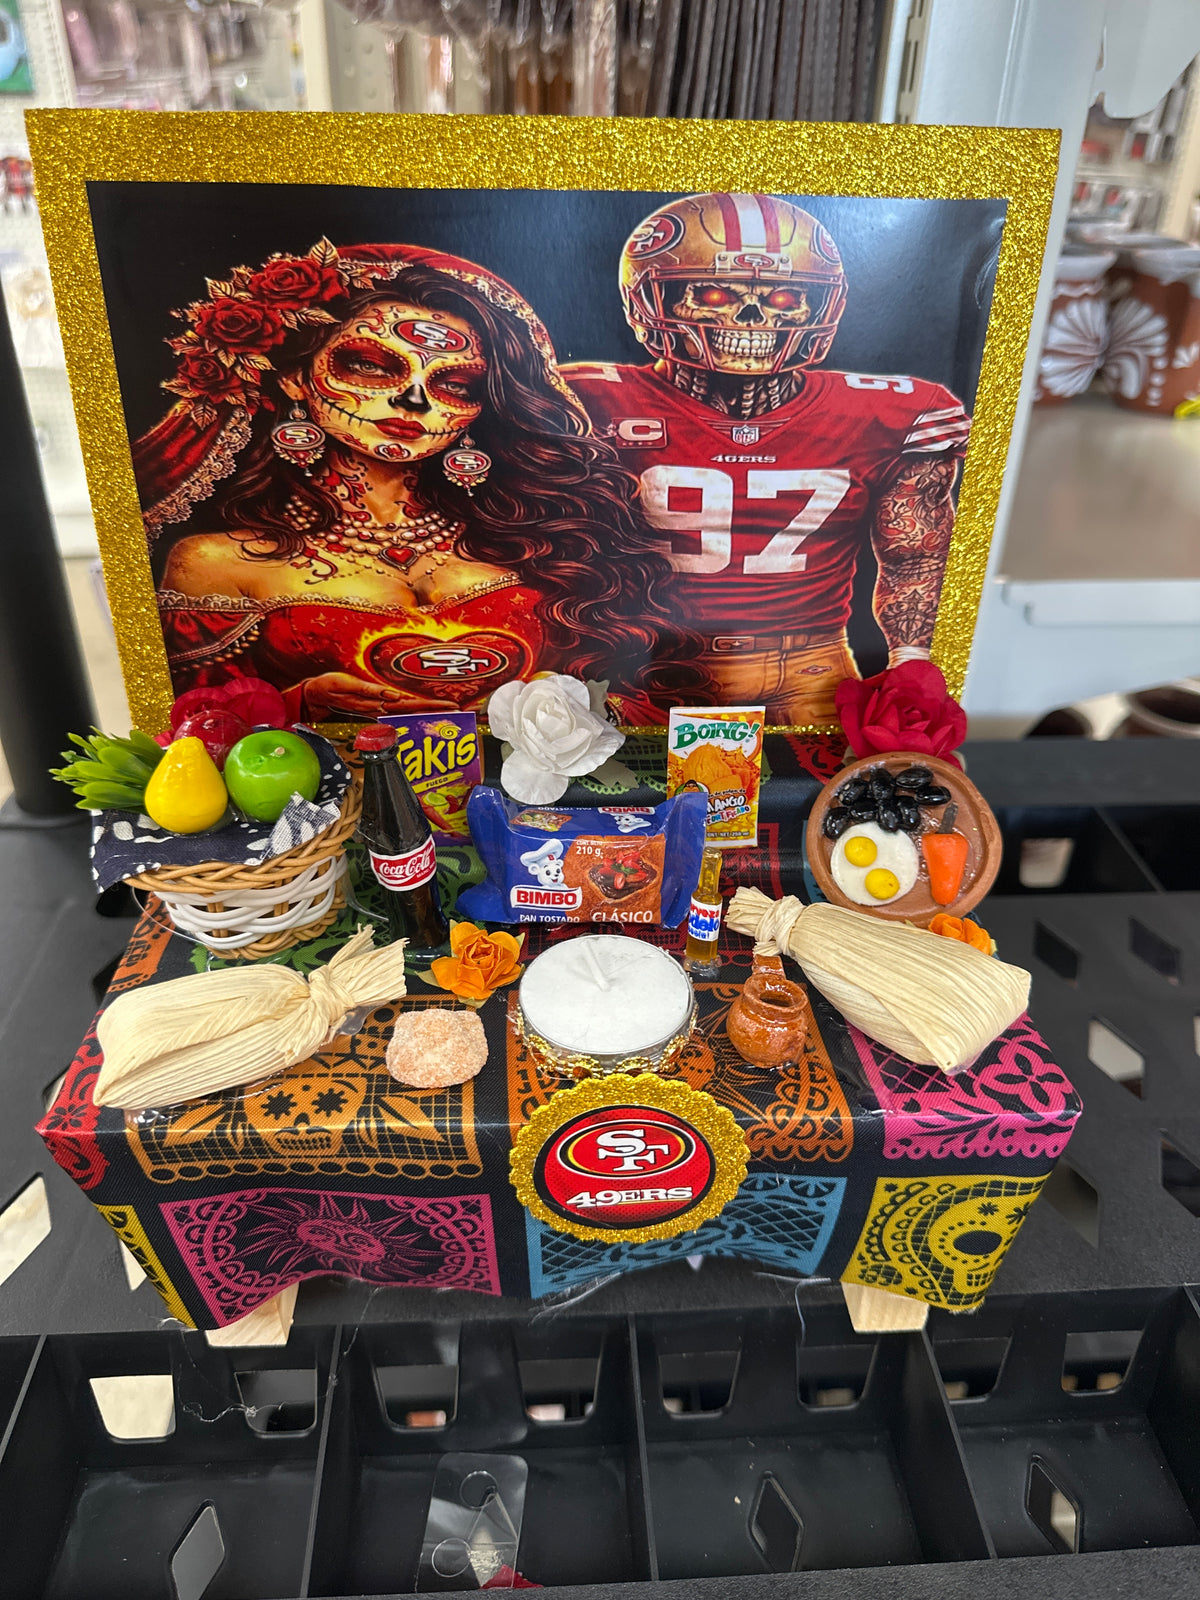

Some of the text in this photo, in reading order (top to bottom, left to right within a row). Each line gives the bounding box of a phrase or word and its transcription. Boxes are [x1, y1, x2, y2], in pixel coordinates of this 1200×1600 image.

[618, 420, 664, 441] C
[640, 465, 851, 575] 97
[576, 846, 593, 855] 210
[516, 890, 577, 907] BIMBO
[592, 908, 654, 923] CLÁSICO
[596, 1129, 669, 1171] SF
[566, 1187, 693, 1208] 49ERS
